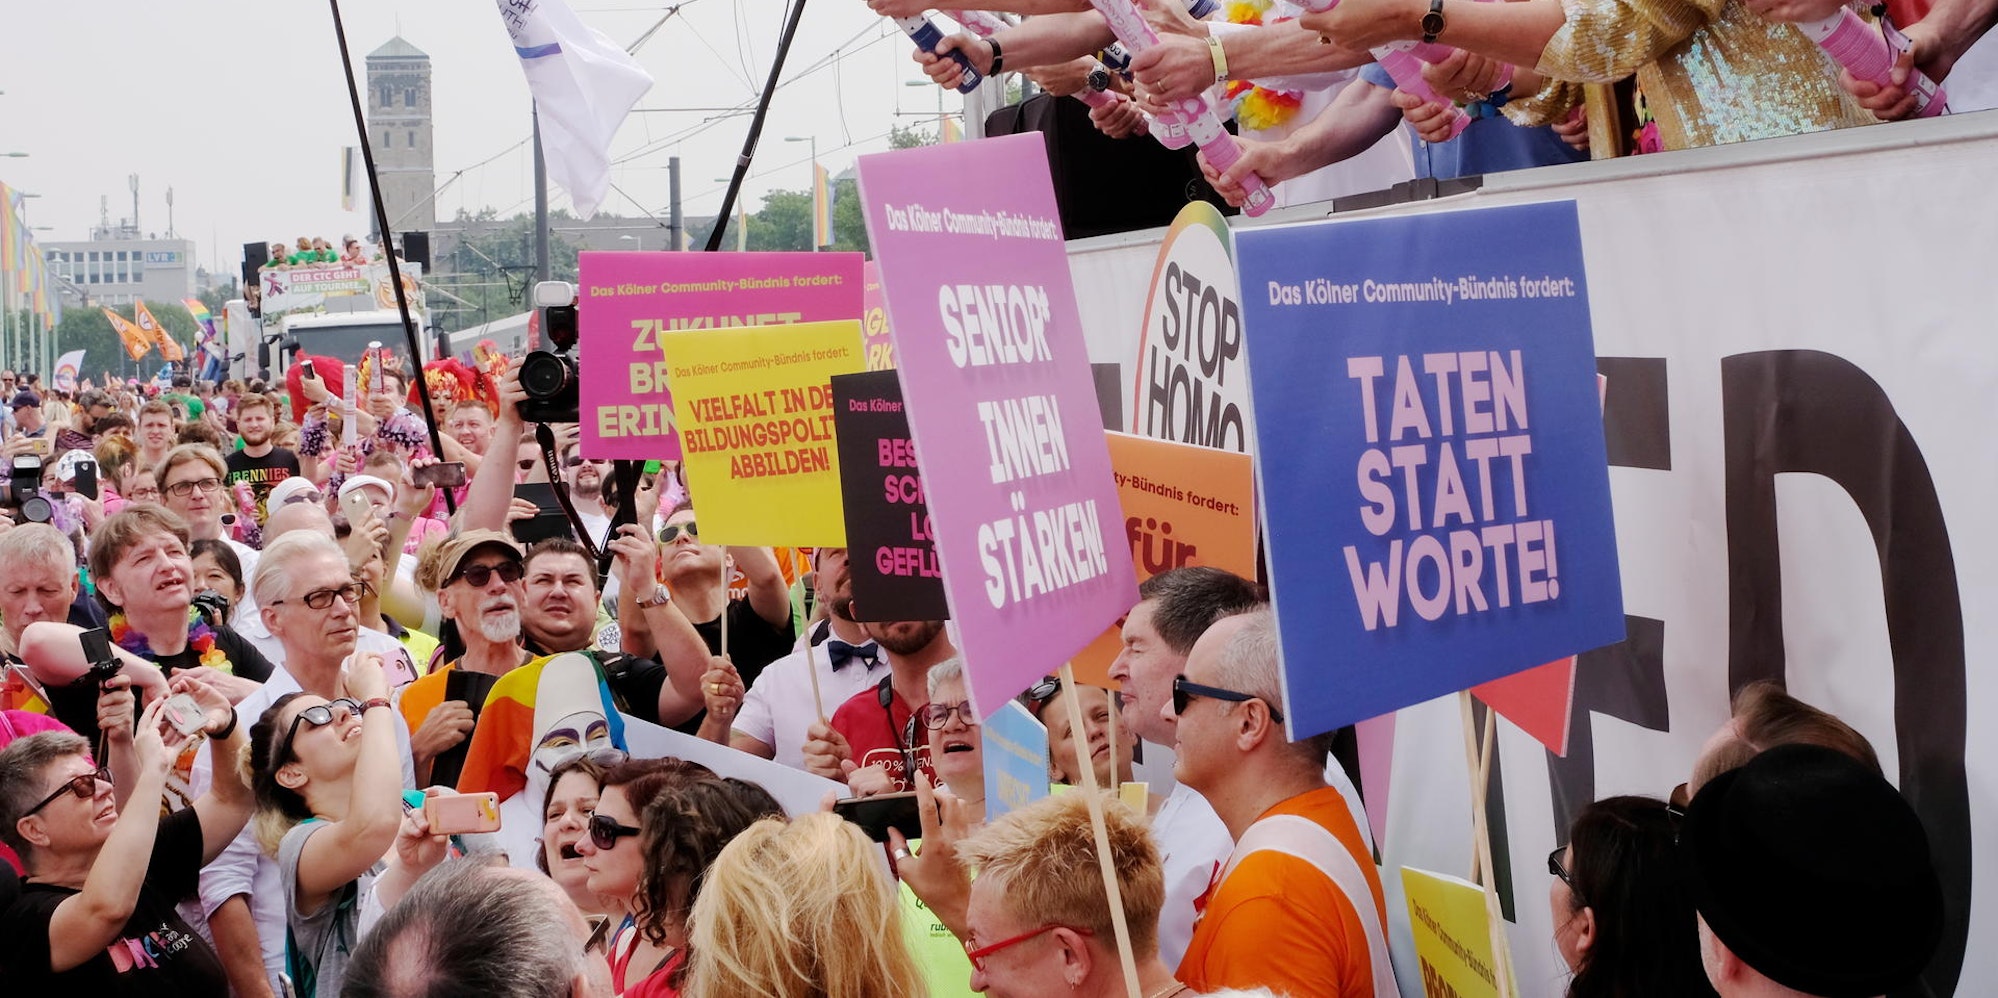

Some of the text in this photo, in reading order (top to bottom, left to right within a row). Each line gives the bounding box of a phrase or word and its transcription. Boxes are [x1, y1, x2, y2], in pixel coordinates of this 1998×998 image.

[885, 203, 908, 231] Das
[907, 203, 943, 232] Kölner
[943, 207, 1029, 240] Community-Bündnis
[147, 252, 169, 263] LVR
[292, 270, 358, 282] DER CTC GEHT
[293, 284, 312, 293] AUF
[590, 274, 843, 297] Das Kölner Community-Bündnis fordert:
[1268, 275, 1575, 305] Das Kölner Community-Bündnis fordert:
[1162, 260, 1241, 387] STOP
[675, 347, 849, 378] Das Kölner Community-Bündnis fordert:
[689, 390, 776, 424] VIELFALT
[780, 387, 805, 414] IN
[849, 398, 902, 412] Das Kölner
[1147, 344, 1245, 453] HOMO
[1346, 349, 1529, 444] TATEN
[977, 393, 1071, 484] INNEN
[547, 449, 559, 484] Canon
[731, 447, 831, 480] ABBILDEN!
[1186, 491, 1239, 516] fordert:
[1356, 434, 1532, 537] STATT
[977, 491, 1108, 609] STÄRKEN!
[1125, 517, 1197, 576] für
[1342, 519, 1560, 632] WORTE!
